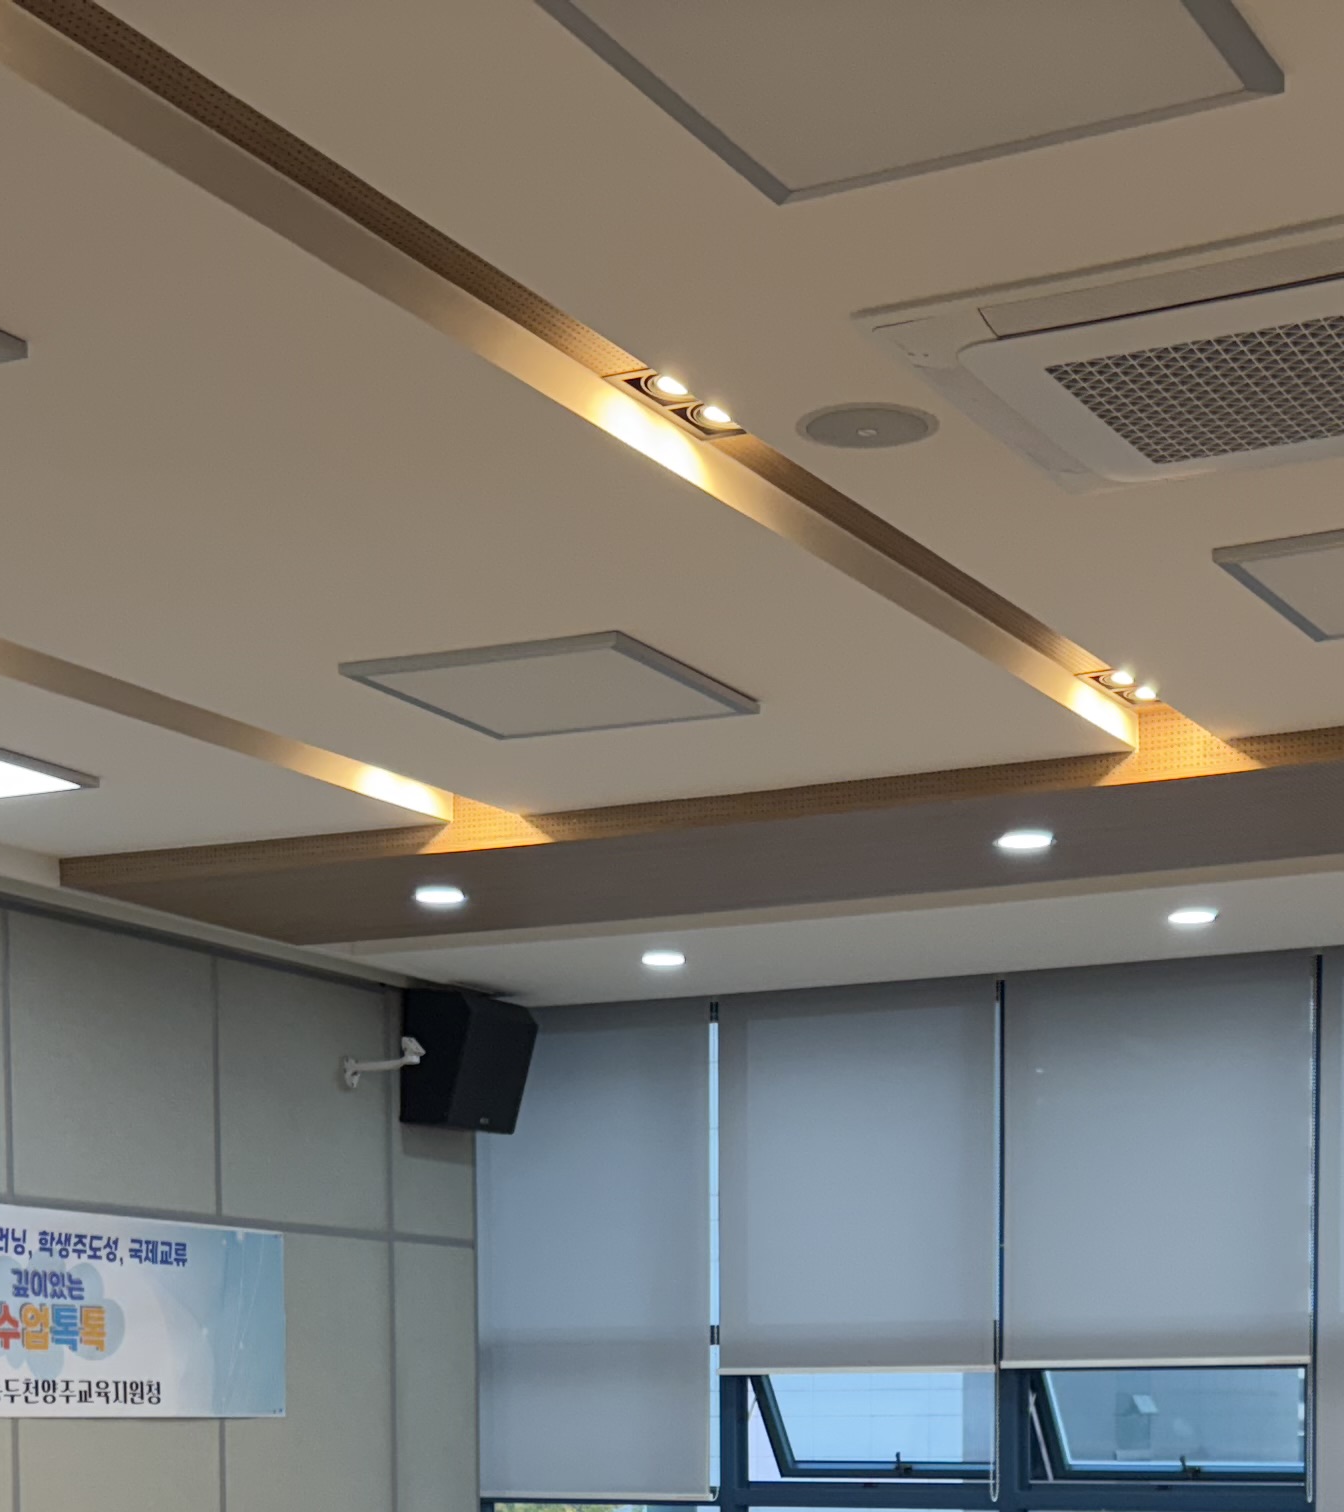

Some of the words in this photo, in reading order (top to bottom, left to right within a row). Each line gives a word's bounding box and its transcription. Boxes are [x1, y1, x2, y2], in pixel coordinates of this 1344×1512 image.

[38, 1230, 124, 1266] 학생주도성,
[128, 1238, 188, 1267] 국제교류
[10, 1268, 86, 1300] 깊이있는
